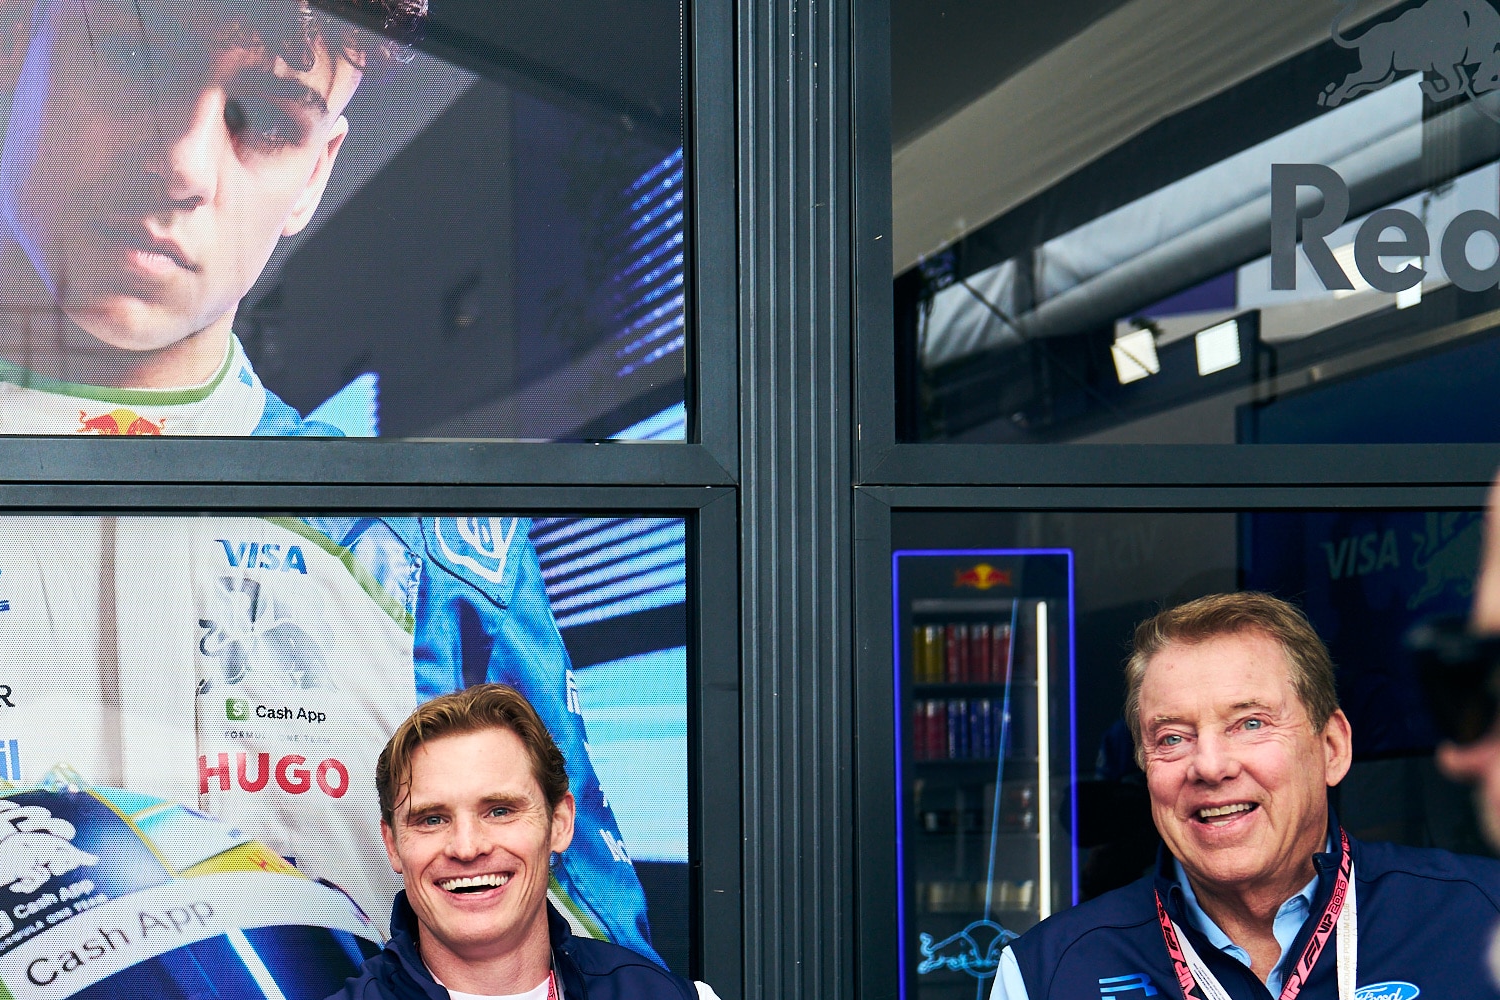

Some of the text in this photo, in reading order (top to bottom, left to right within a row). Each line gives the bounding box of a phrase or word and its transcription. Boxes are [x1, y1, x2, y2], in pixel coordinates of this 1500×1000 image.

[214, 539, 308, 575] VISA
[1322, 528, 1399, 580] VISA
[256, 704, 293, 720] Cash
[296, 706, 327, 724] App
[199, 752, 350, 799] HUGO
[27, 927, 131, 987] Cash
[138, 900, 214, 937] App
